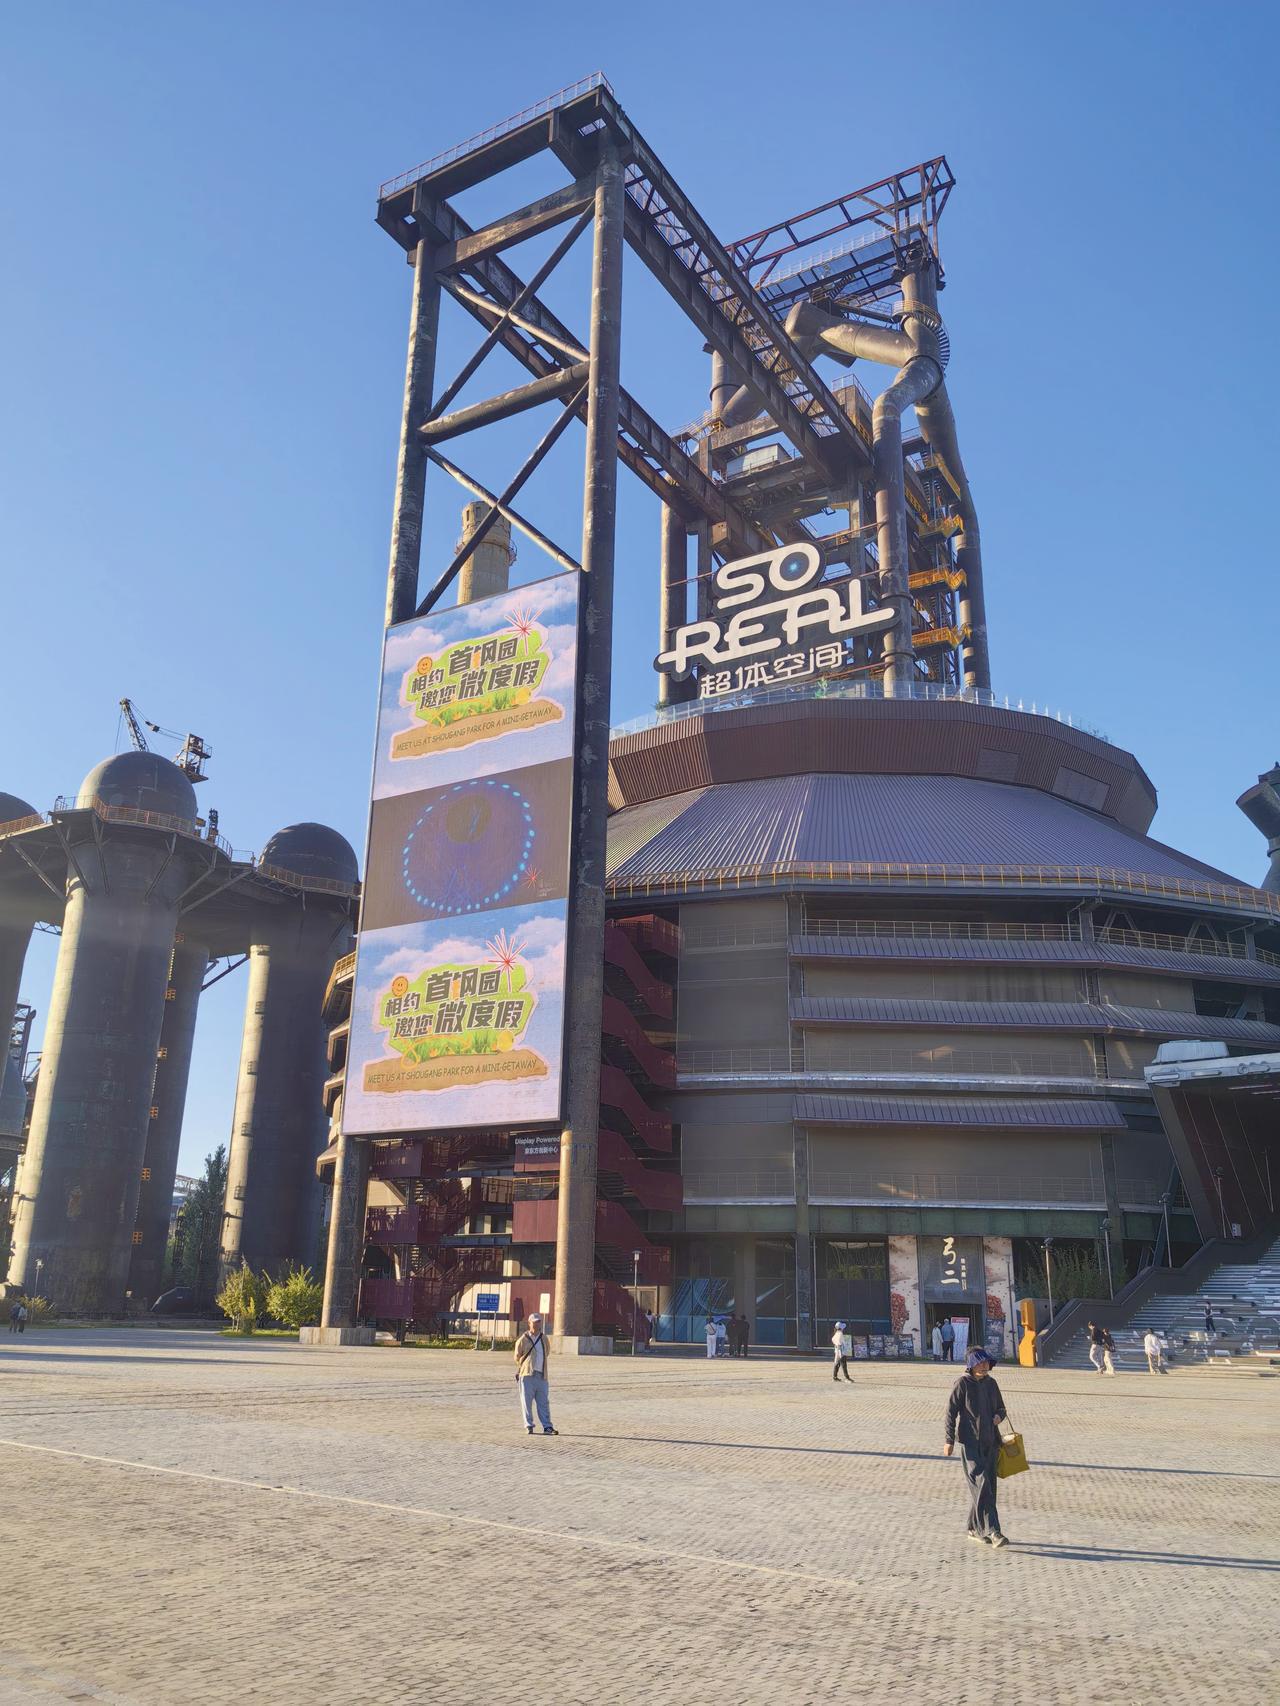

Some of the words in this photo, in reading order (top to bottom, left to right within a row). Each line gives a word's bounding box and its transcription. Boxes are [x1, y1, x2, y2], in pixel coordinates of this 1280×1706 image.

[717, 542, 821, 609] SO
[657, 579, 895, 673] REAL
[700, 642, 849, 699] 超体空间
[397, 741, 413, 752] MEET
[413, 739, 422, 748] US
[423, 737, 433, 746] AT
[432, 729, 466, 742] SHOUGANG
[467, 725, 481, 735] PARK
[482, 722, 495, 732] FOR
[367, 1074, 385, 1084] MEET
[386, 1072, 395, 1081] US
[396, 1071, 406, 1080] AT
[406, 1068, 443, 1080] SHOUGANG
[443, 1067, 460, 1077] PARK
[460, 1066, 474, 1075] FOR
[514, 1137, 535, 1145] Display
